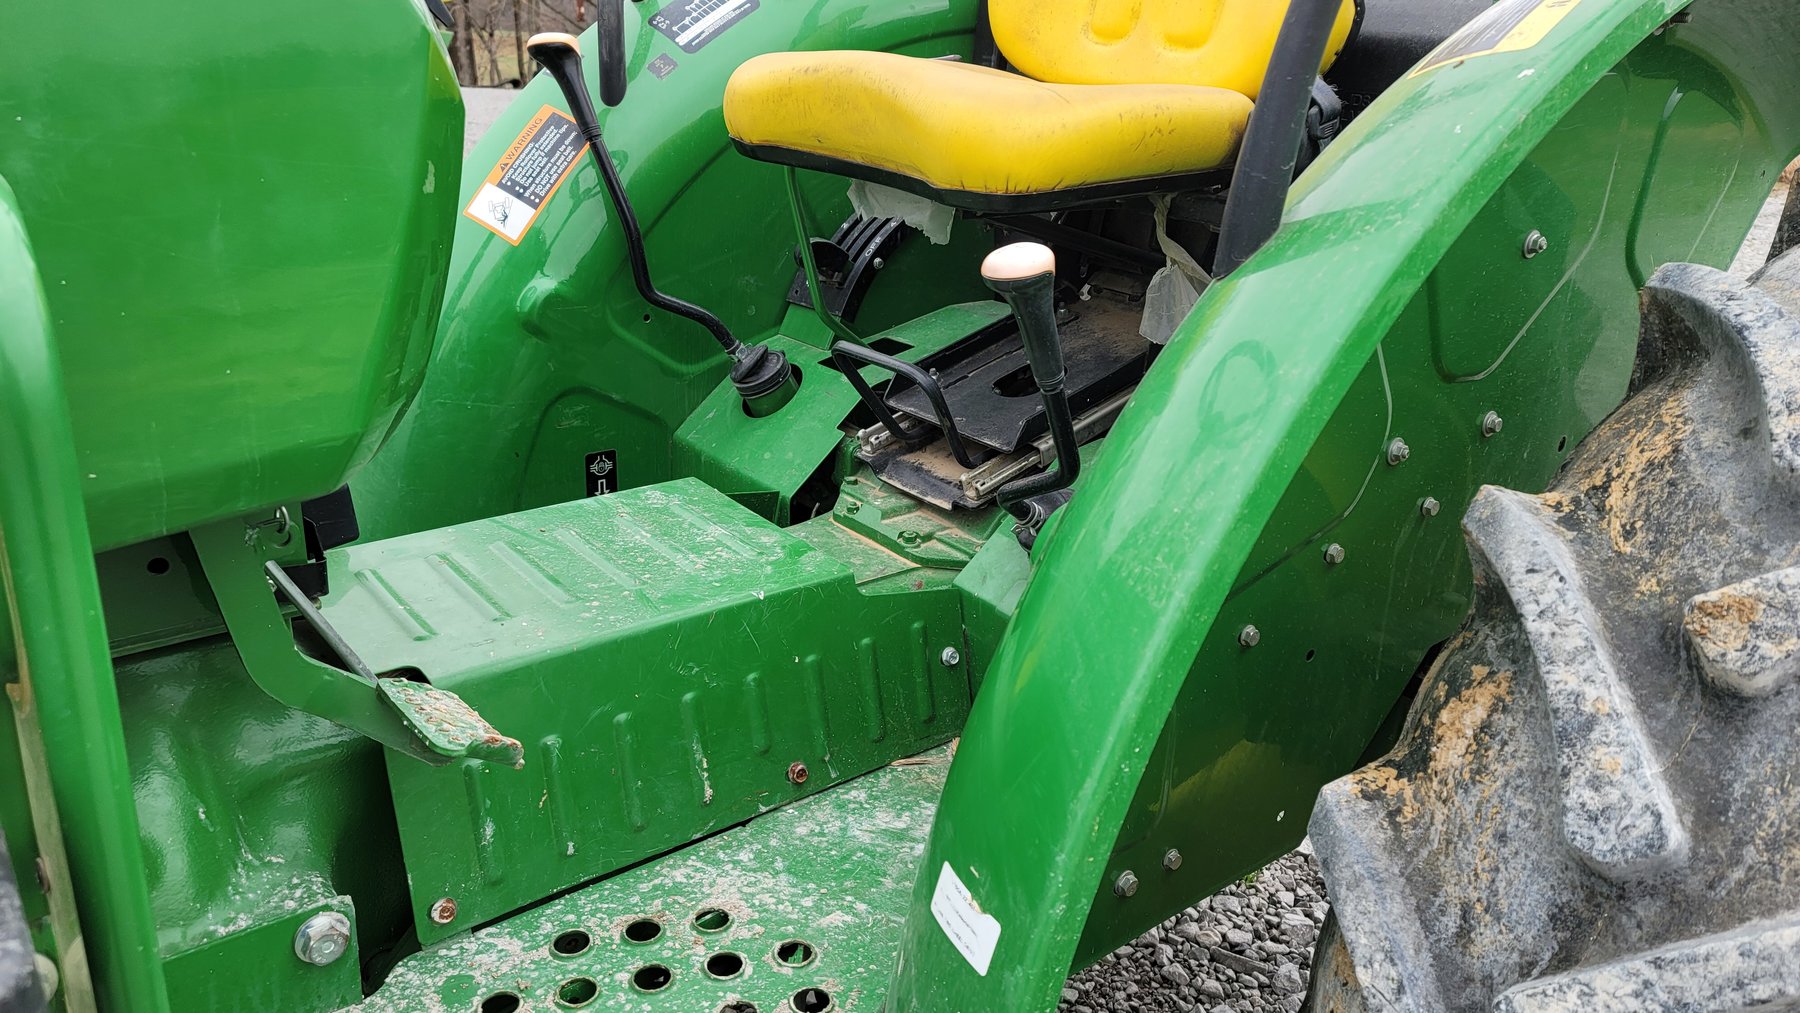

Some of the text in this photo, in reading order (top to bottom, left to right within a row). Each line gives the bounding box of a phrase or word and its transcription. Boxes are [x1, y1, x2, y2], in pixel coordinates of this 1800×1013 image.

[505, 116, 542, 161] WARNING
[511, 166, 523, 179] Keep
[534, 124, 554, 148] Protective
[519, 176, 527, 184] Do
[543, 132, 560, 152] machine
[501, 168, 514, 183] AVOID
[523, 182, 537, 197] When
[533, 162, 552, 183] structure
[549, 150, 561, 163] must
[523, 176, 533, 186] Use
[534, 184, 543, 193] DO
[540, 173, 551, 185] NOT
[539, 182, 551, 196] Drive
[865, 236, 882, 257] OFF
